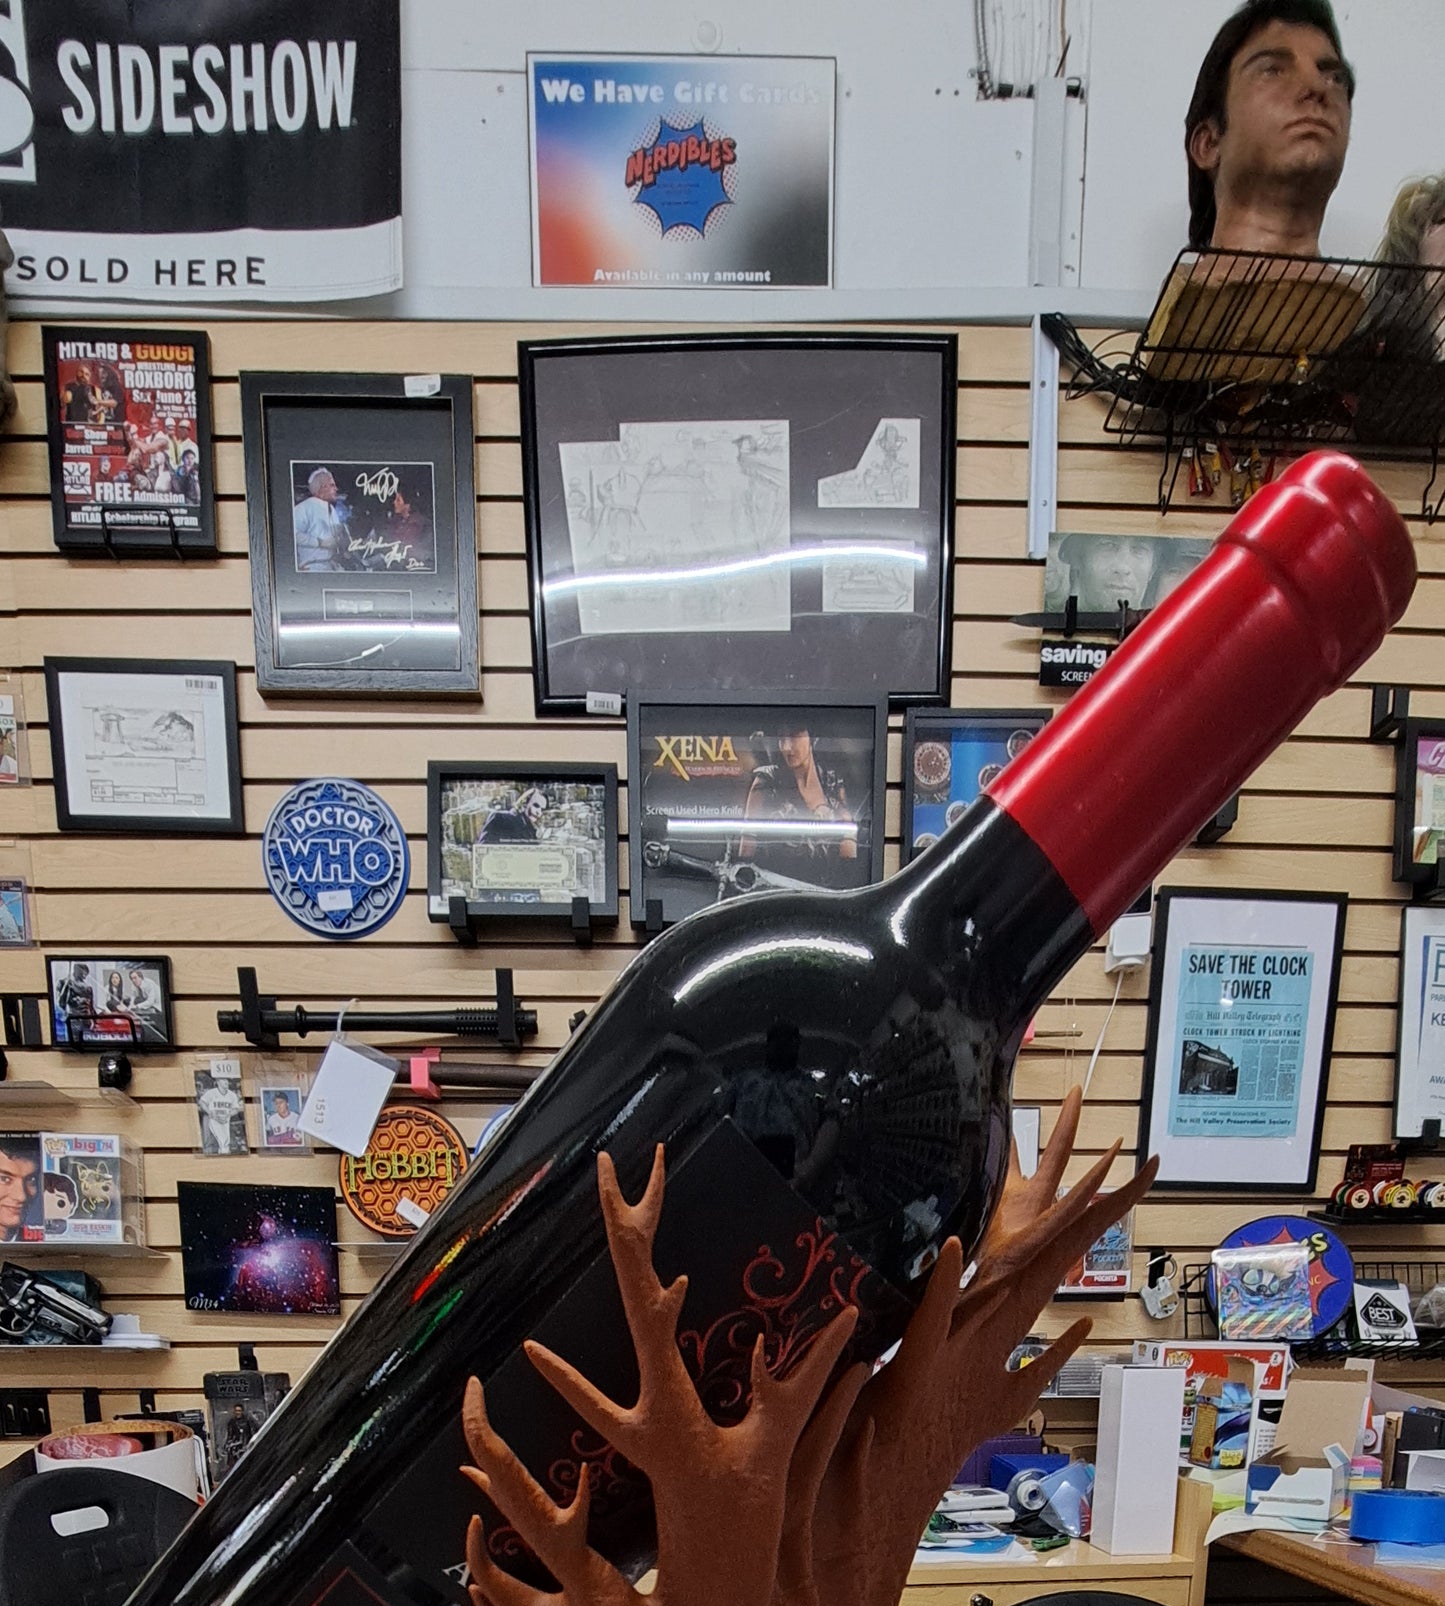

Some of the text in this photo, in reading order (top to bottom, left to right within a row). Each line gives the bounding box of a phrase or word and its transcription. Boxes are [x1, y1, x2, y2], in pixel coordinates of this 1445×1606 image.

[57, 39, 357, 136] SIDESHOW
[541, 78, 820, 104] We Have Gift Cards
[625, 134, 737, 188] NERDIBLES
[16, 256, 267, 286] SOLD HERE
[684, 270, 709, 284] any
[714, 269, 771, 283] amount
[58, 341, 118, 360] HITLAB
[121, 343, 132, 360] &
[124, 370, 195, 390] ROXBORO
[94, 482, 185, 504] FREE Admission
[160, 513, 198, 527] Prgram
[1041, 644, 1107, 668] saving
[654, 735, 738, 781] XENA
[646, 804, 743, 816] Screen Used Hero Knife
[290, 806, 374, 837] DOCTOR
[276, 838, 395, 886] WHO
[1189, 954, 1308, 976] SAVE THE CLOCK
[1221, 979, 1272, 1000] TOWER
[1183, 1027, 1203, 1036] CLOCK
[1231, 1028, 1255, 1037] STRUCK
[216, 1063, 232, 1073] $10
[314, 1098, 326, 1124] 1513
[1202, 1118, 1224, 1126] Valley
[74, 1137, 97, 1153] big
[347, 1148, 459, 1193] HOBBIT
[1368, 1306, 1395, 1320] BEST
[220, 1377, 249, 1385] STAR
